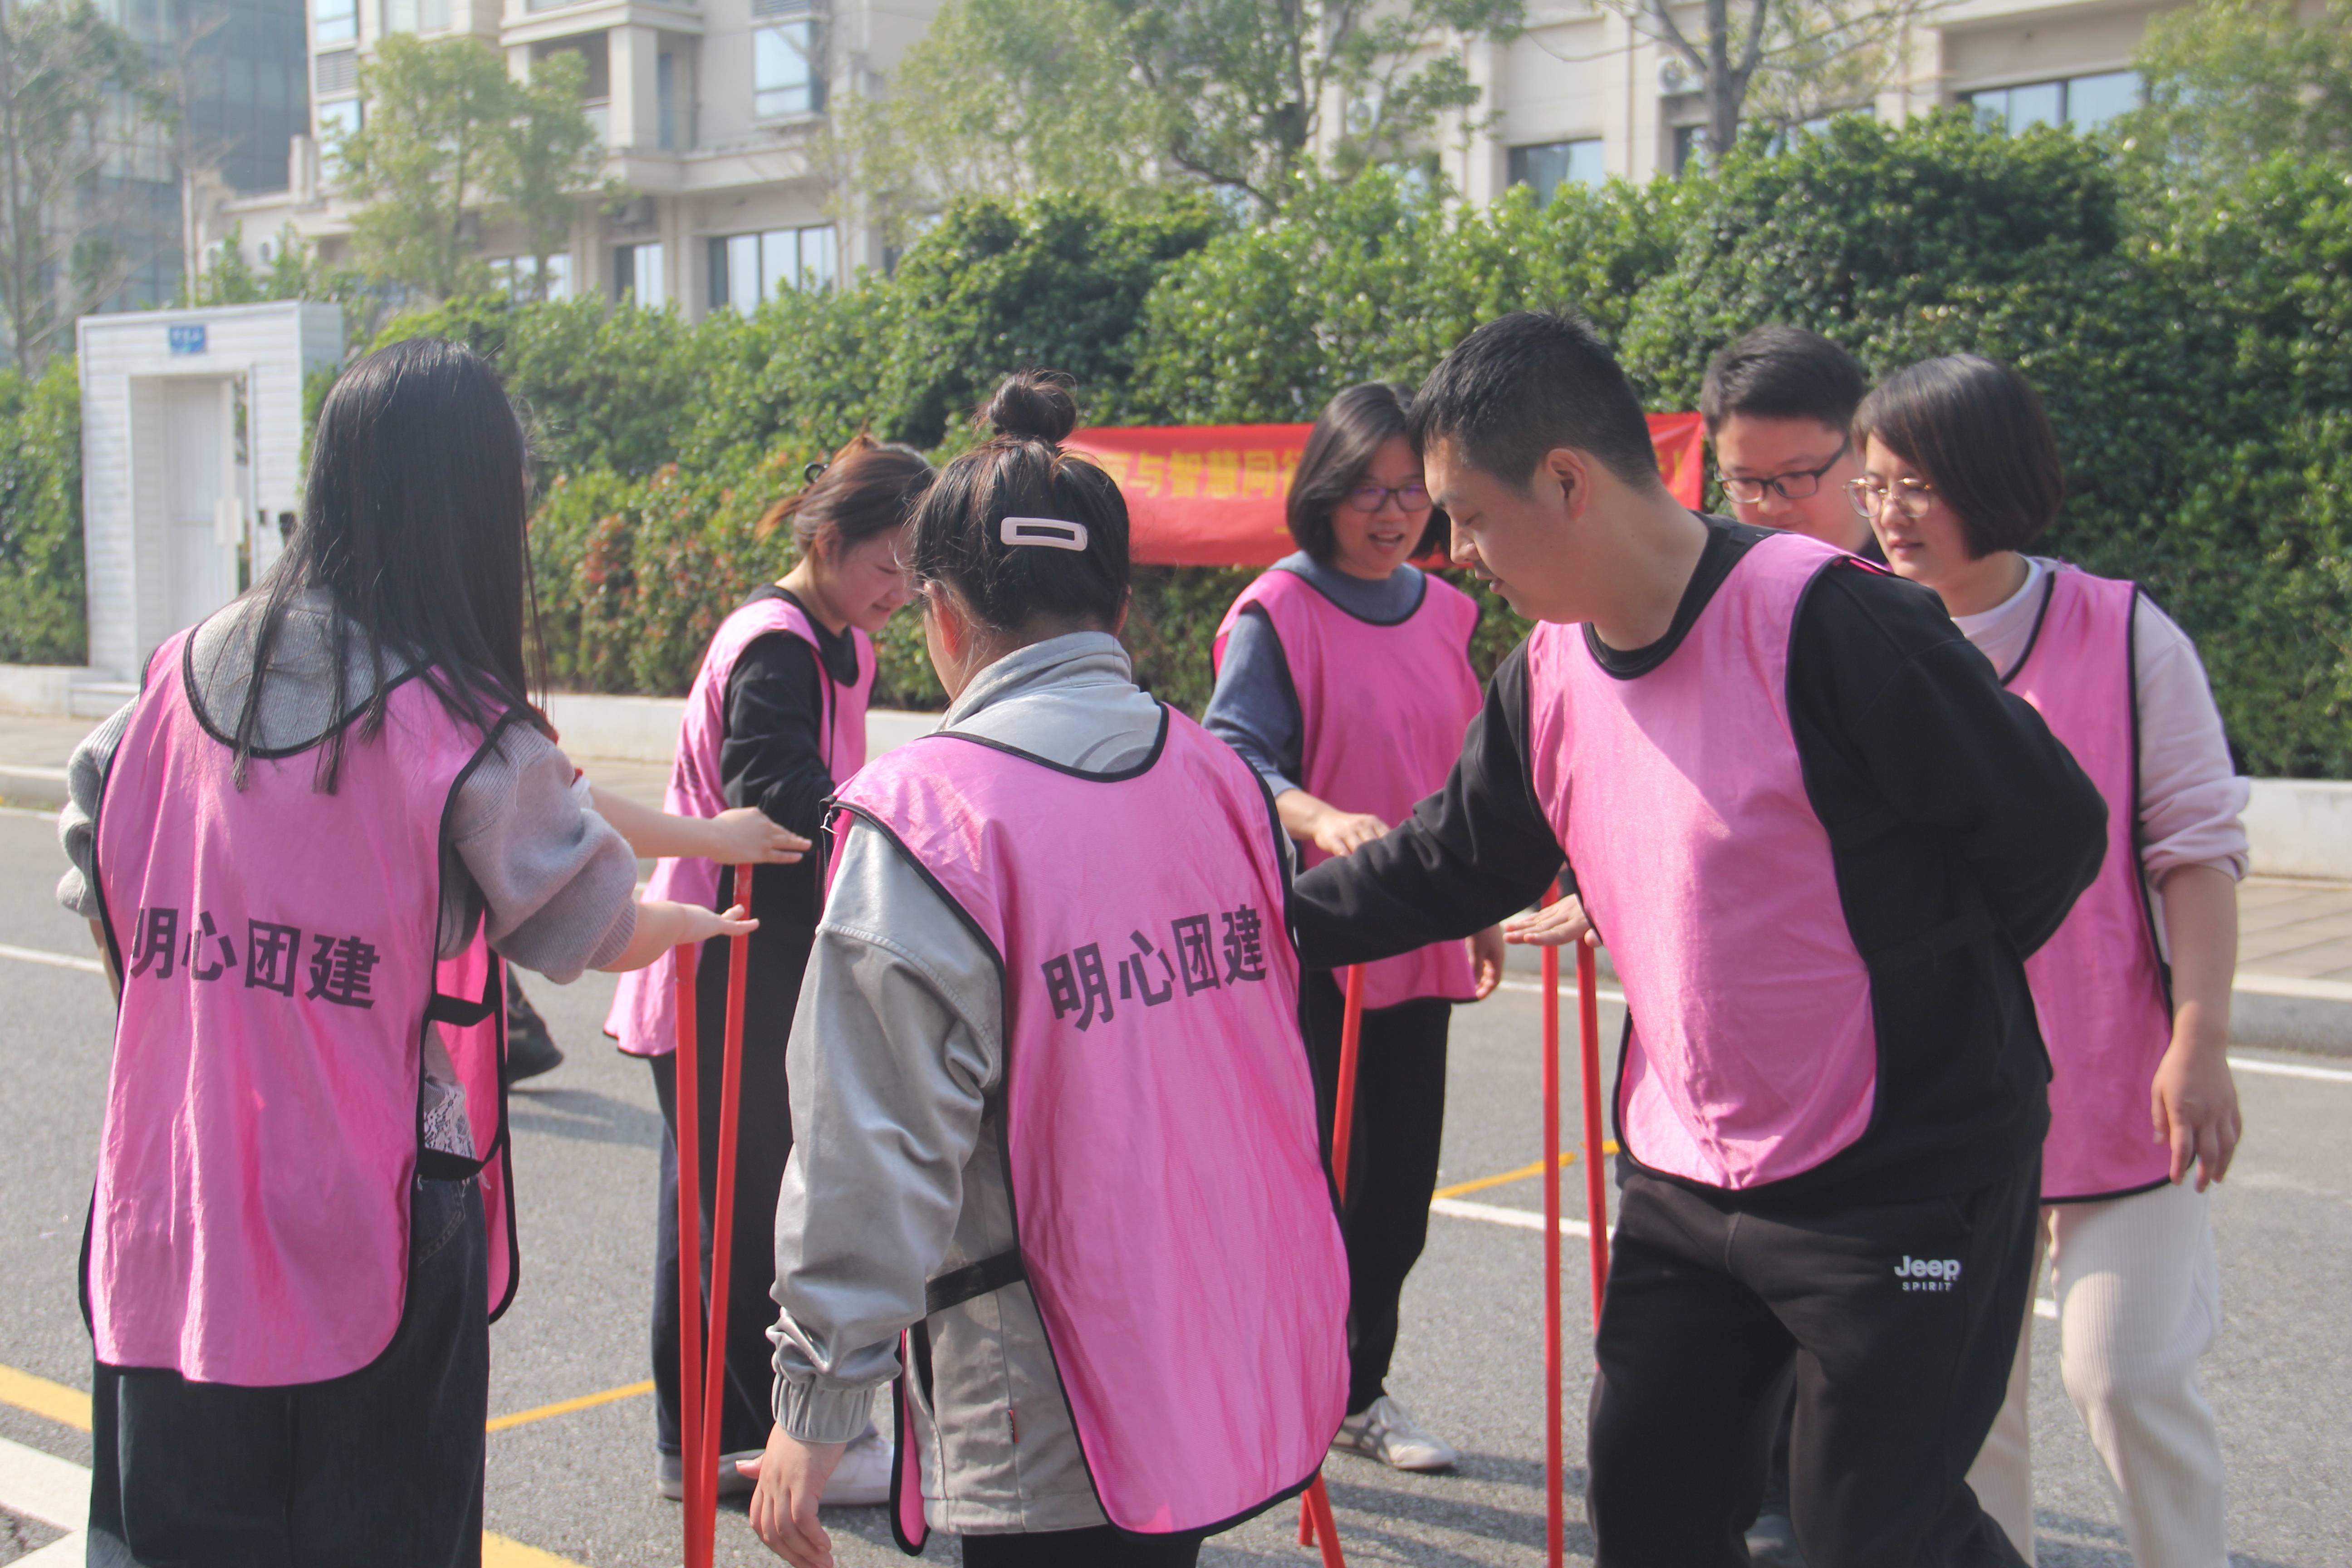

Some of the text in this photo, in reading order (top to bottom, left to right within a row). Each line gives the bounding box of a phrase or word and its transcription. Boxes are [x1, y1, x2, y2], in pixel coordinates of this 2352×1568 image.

[1041, 904, 1266, 1032] 明心团建
[1894, 1255, 1960, 1280] Jeep
[1902, 1282, 1952, 1291] SPIRIT
